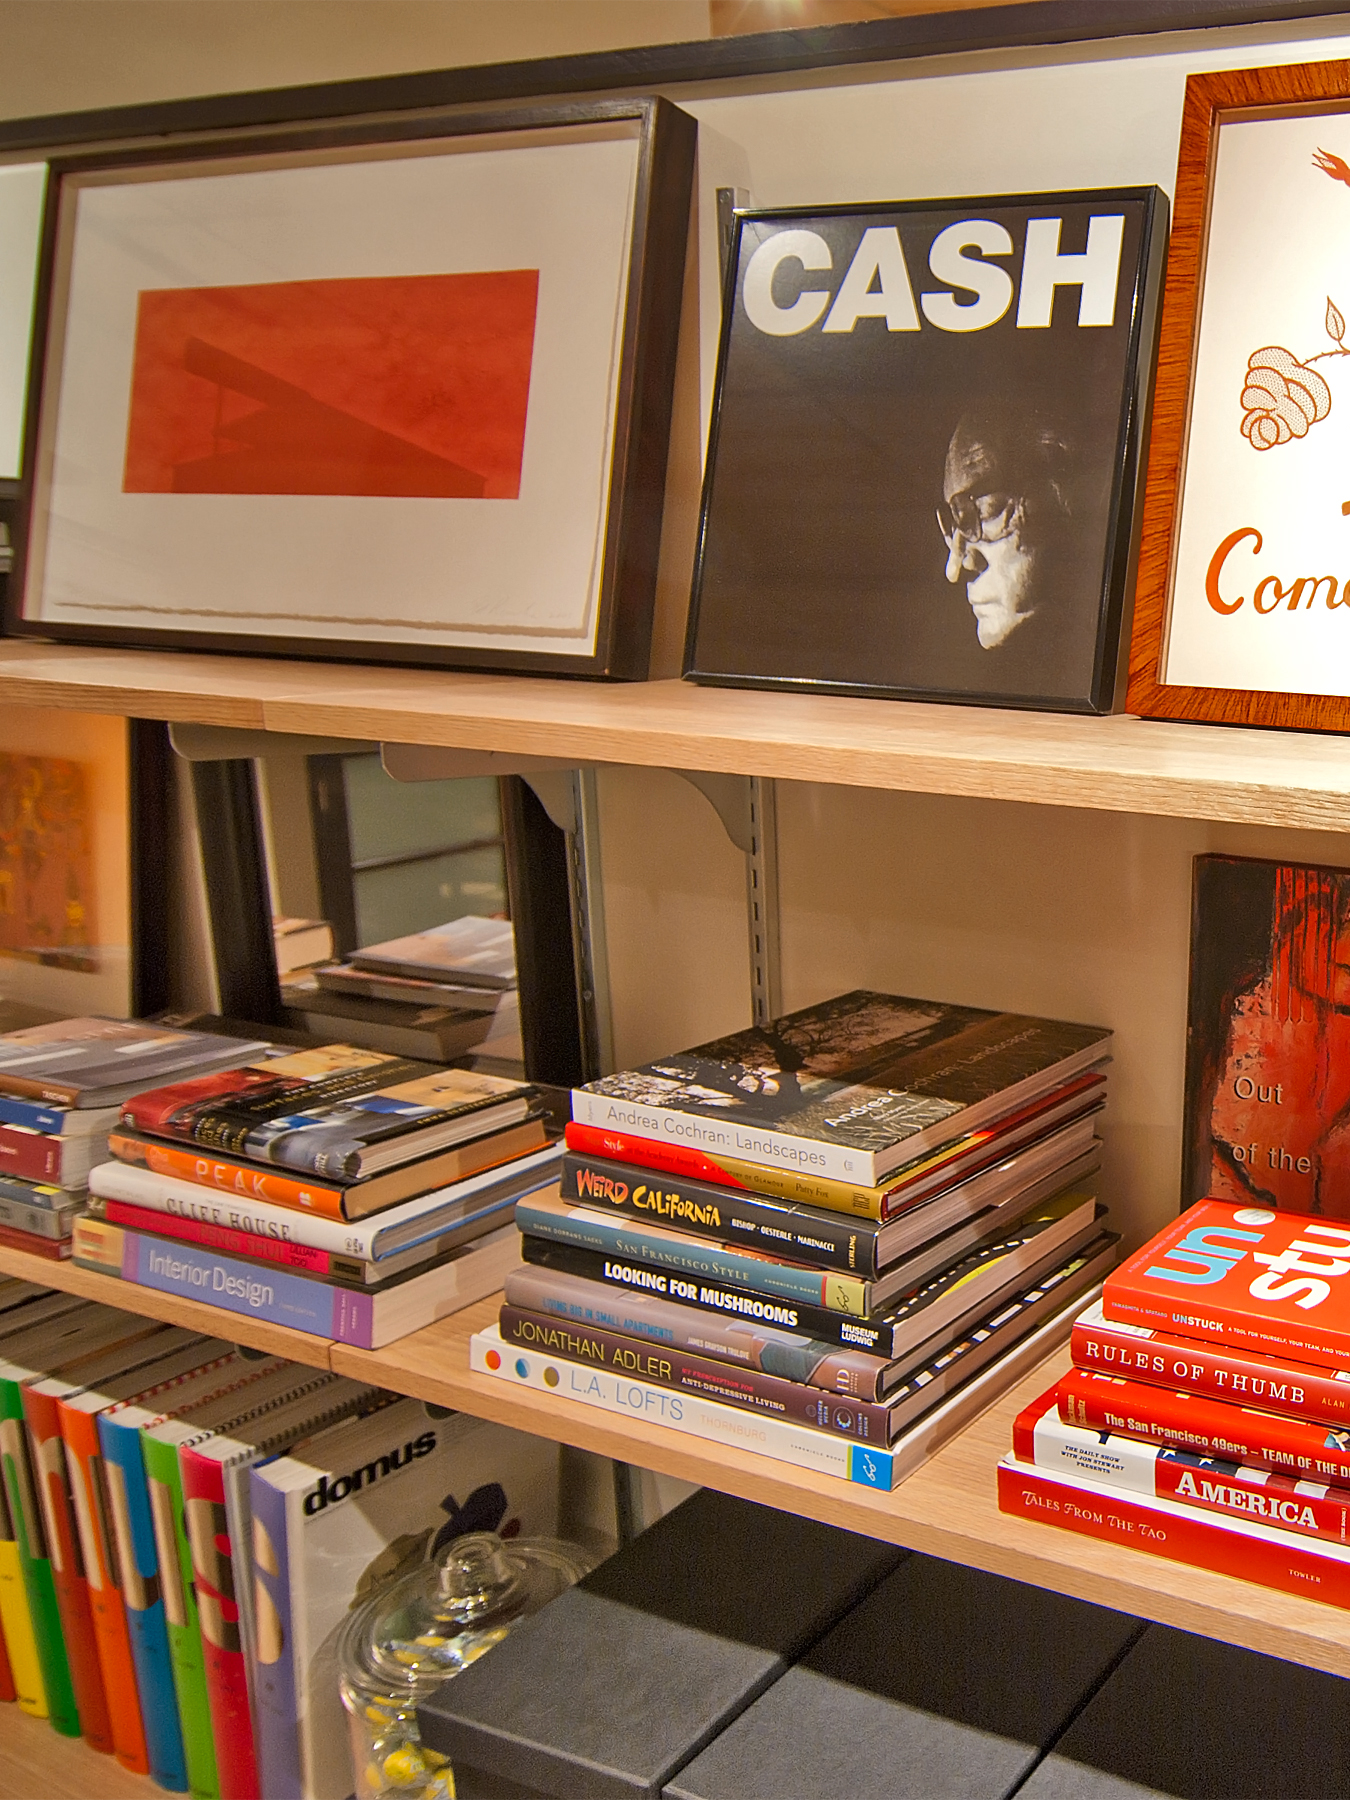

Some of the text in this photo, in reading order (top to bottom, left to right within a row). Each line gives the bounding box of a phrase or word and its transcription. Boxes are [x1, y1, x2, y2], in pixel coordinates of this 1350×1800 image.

[742, 215, 1125, 337] CASH
[1234, 1075, 1284, 1106] Out
[824, 1095, 892, 1127] Andrea
[603, 1137, 625, 1154] Style
[607, 1105, 827, 1166] Andrea Cochran: Landscapes
[1232, 1143, 1312, 1174] of the
[195, 1160, 269, 1198] PEAK
[795, 1183, 829, 1199] Patty Fox
[166, 1198, 221, 1225] CLIFF
[229, 1212, 290, 1241] HOUSE
[533, 1223, 551, 1233] DIANE
[731, 1218, 835, 1252] BISHOP OESTERLE MARINACCI
[616, 1239, 750, 1281] SAN FRANCISCO STYLE
[848, 1234, 857, 1268] STERLING
[1144, 1226, 1266, 1285] un
[149, 1250, 274, 1307] Interior Design
[603, 1261, 798, 1327] LOOKING FOR MUSHROOMS
[543, 1298, 673, 1341] LIVING BIG IN SMALL APARTMENTS
[841, 1322, 879, 1340] MUSEUM
[1172, 1312, 1225, 1333] UNSTUCK
[513, 1320, 671, 1379] JONATHAN ADLER
[841, 1332, 874, 1348] LUDWIG
[1233, 1328, 1247, 1336] TOOL
[1248, 1330, 1259, 1338] FOR
[1259, 1333, 1288, 1345] YOURSELF,
[1288, 1339, 1304, 1348] YOUR
[1304, 1342, 1322, 1353] TEAM,
[1322, 1346, 1335, 1354] AND
[1335, 1348, 1350, 1357] YOUR
[1085, 1340, 1306, 1404] RULES OF THUMB
[571, 1370, 684, 1421] L.A. LOFTS
[681, 1376, 785, 1412] ANTI-DEPRESSIVE LIVING
[1321, 1397, 1345, 1410] ALAN
[700, 1414, 767, 1442] THORNBURG
[1104, 1412, 1125, 1429] The
[1127, 1417, 1149, 1433] San
[1151, 1422, 1209, 1447] Francisco
[1211, 1437, 1248, 1456] 49ers
[1261, 1447, 1295, 1466] TEAM
[1297, 1455, 1312, 1469] OF
[1315, 1459, 1338, 1476] THE
[1060, 1450, 1125, 1471] WITH JON STEWART
[1065, 1444, 1121, 1463] THE DAILY SHOW
[1076, 1461, 1111, 1474] PRESENTS
[303, 1430, 437, 1517] domus
[1022, 1490, 1167, 1541] TALES FROM THE TAO
[1175, 1471, 1319, 1530] AMERICA
[1288, 1568, 1321, 1583] TOWLER
